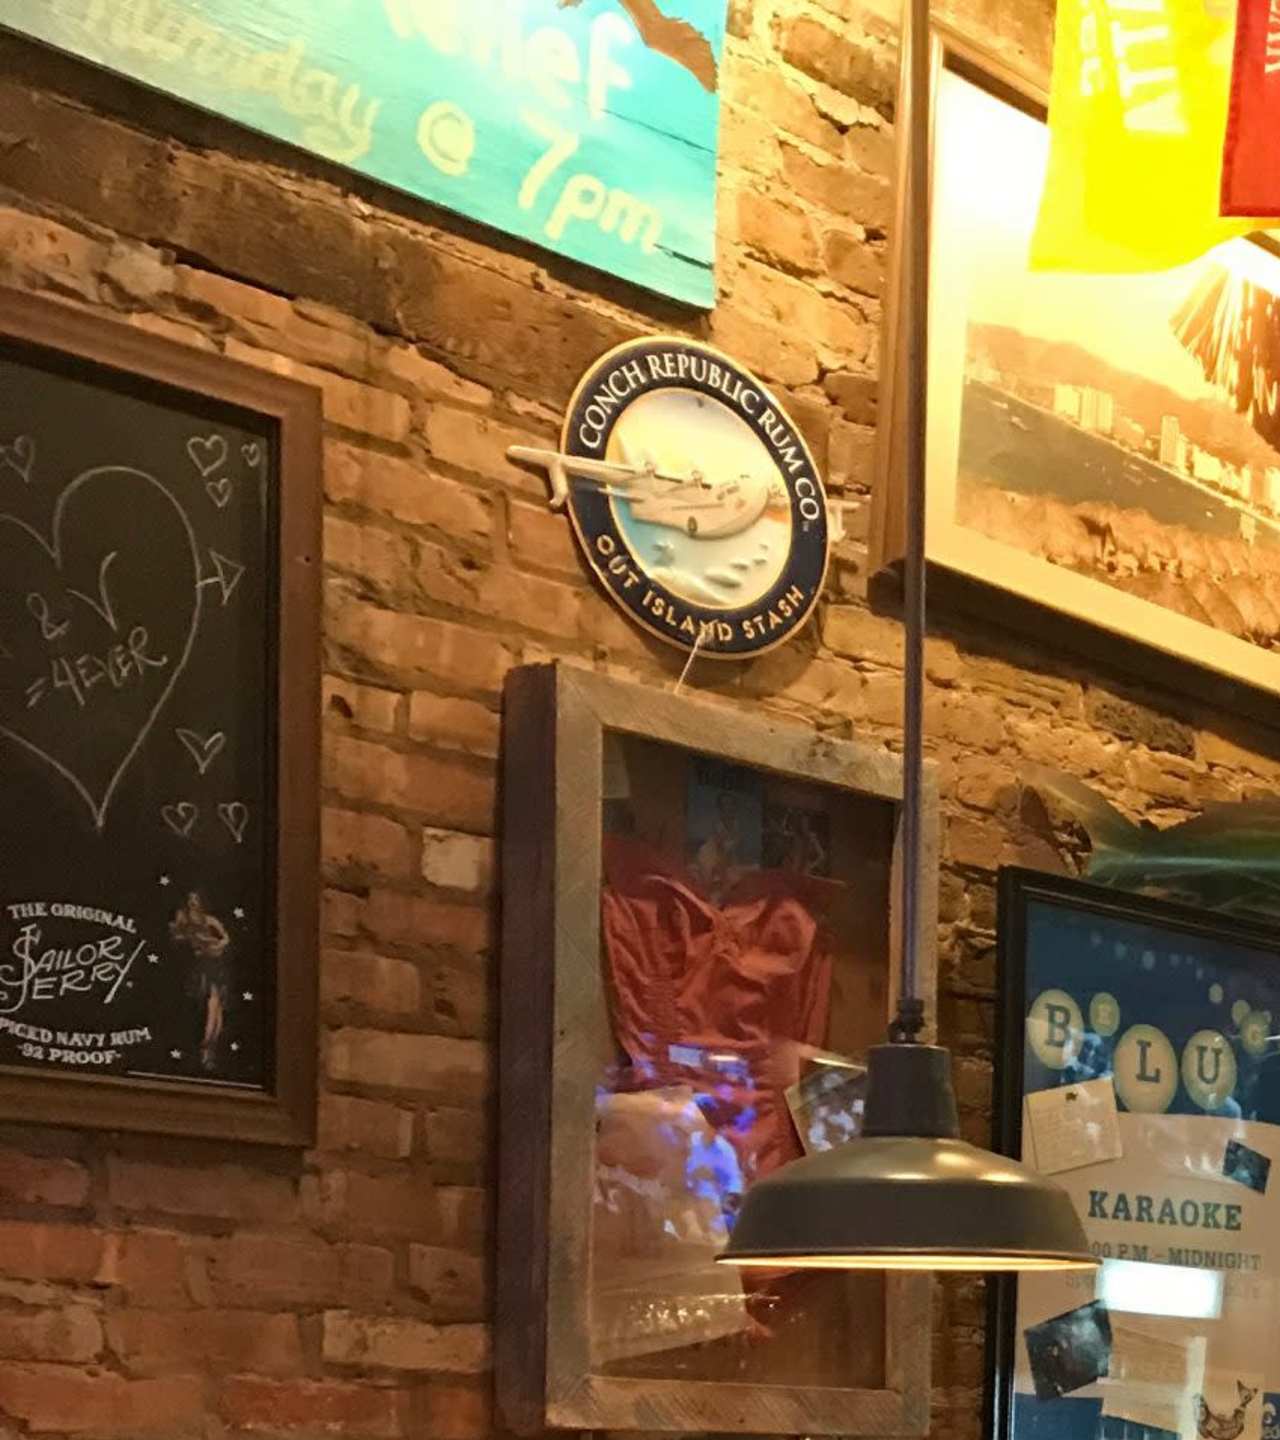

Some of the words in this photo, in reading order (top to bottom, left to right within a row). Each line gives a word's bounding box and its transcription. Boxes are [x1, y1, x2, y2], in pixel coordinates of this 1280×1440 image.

[579, 358, 648, 450] CONCH
[647, 353, 761, 415] REPUBLIC
[756, 411, 804, 475] RUM
[596, 532, 641, 590] OUT
[641, 590, 734, 643] ISLAND
[741, 584, 806, 641] STASH
[7, 902, 49, 920] THE
[50, 902, 139, 935] ORIGINAL
[0, 1017, 52, 1044] PICED
[56, 1031, 108, 1048] NAVY
[110, 1026, 152, 1047] RUM
[1087, 1189, 1243, 1232] KARAOKE
[1167, 1246, 1262, 1272] MIDNIGHT
